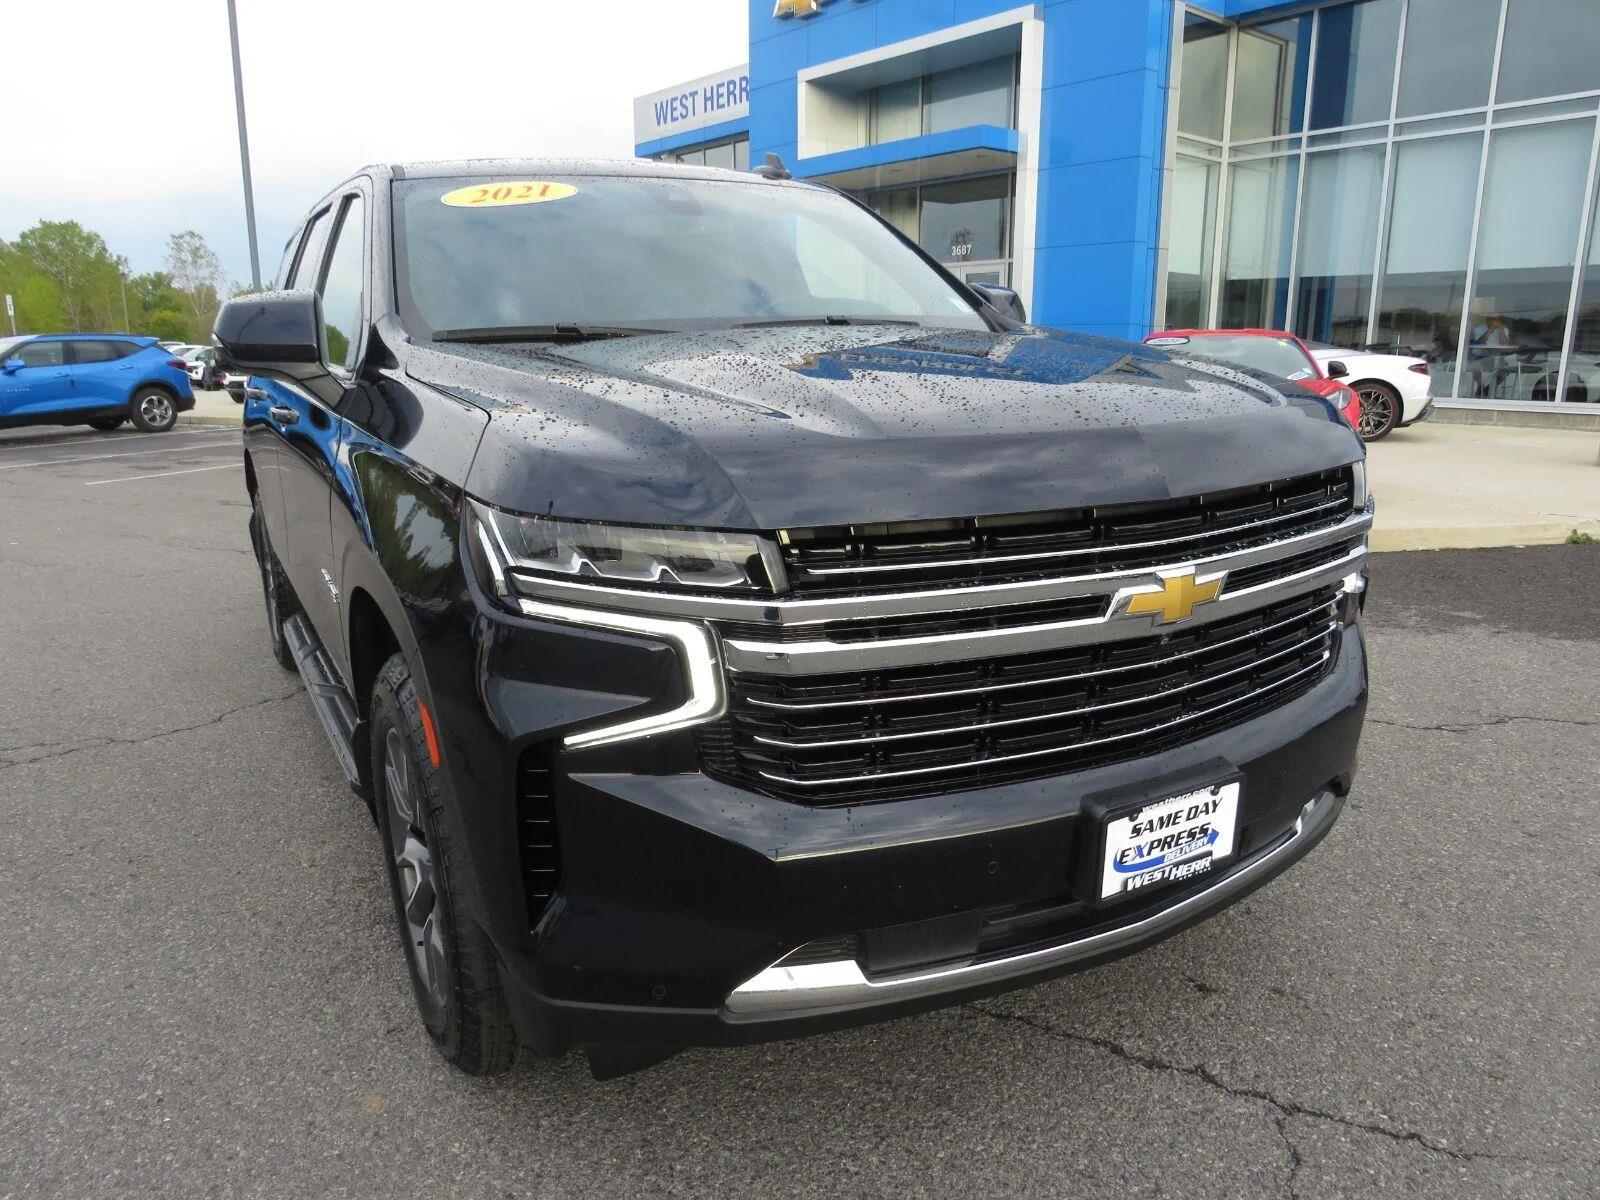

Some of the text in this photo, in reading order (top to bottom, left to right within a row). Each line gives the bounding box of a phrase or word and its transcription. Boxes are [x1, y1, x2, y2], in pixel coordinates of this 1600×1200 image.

[654, 75, 749, 127] WEST HERR
[469, 184, 551, 204] 2021
[951, 244, 972, 256] 3687
[1129, 797, 1223, 840] SAME DAY
[1118, 822, 1212, 865] EXPRESS
[1164, 837, 1210, 863] DELIVERY
